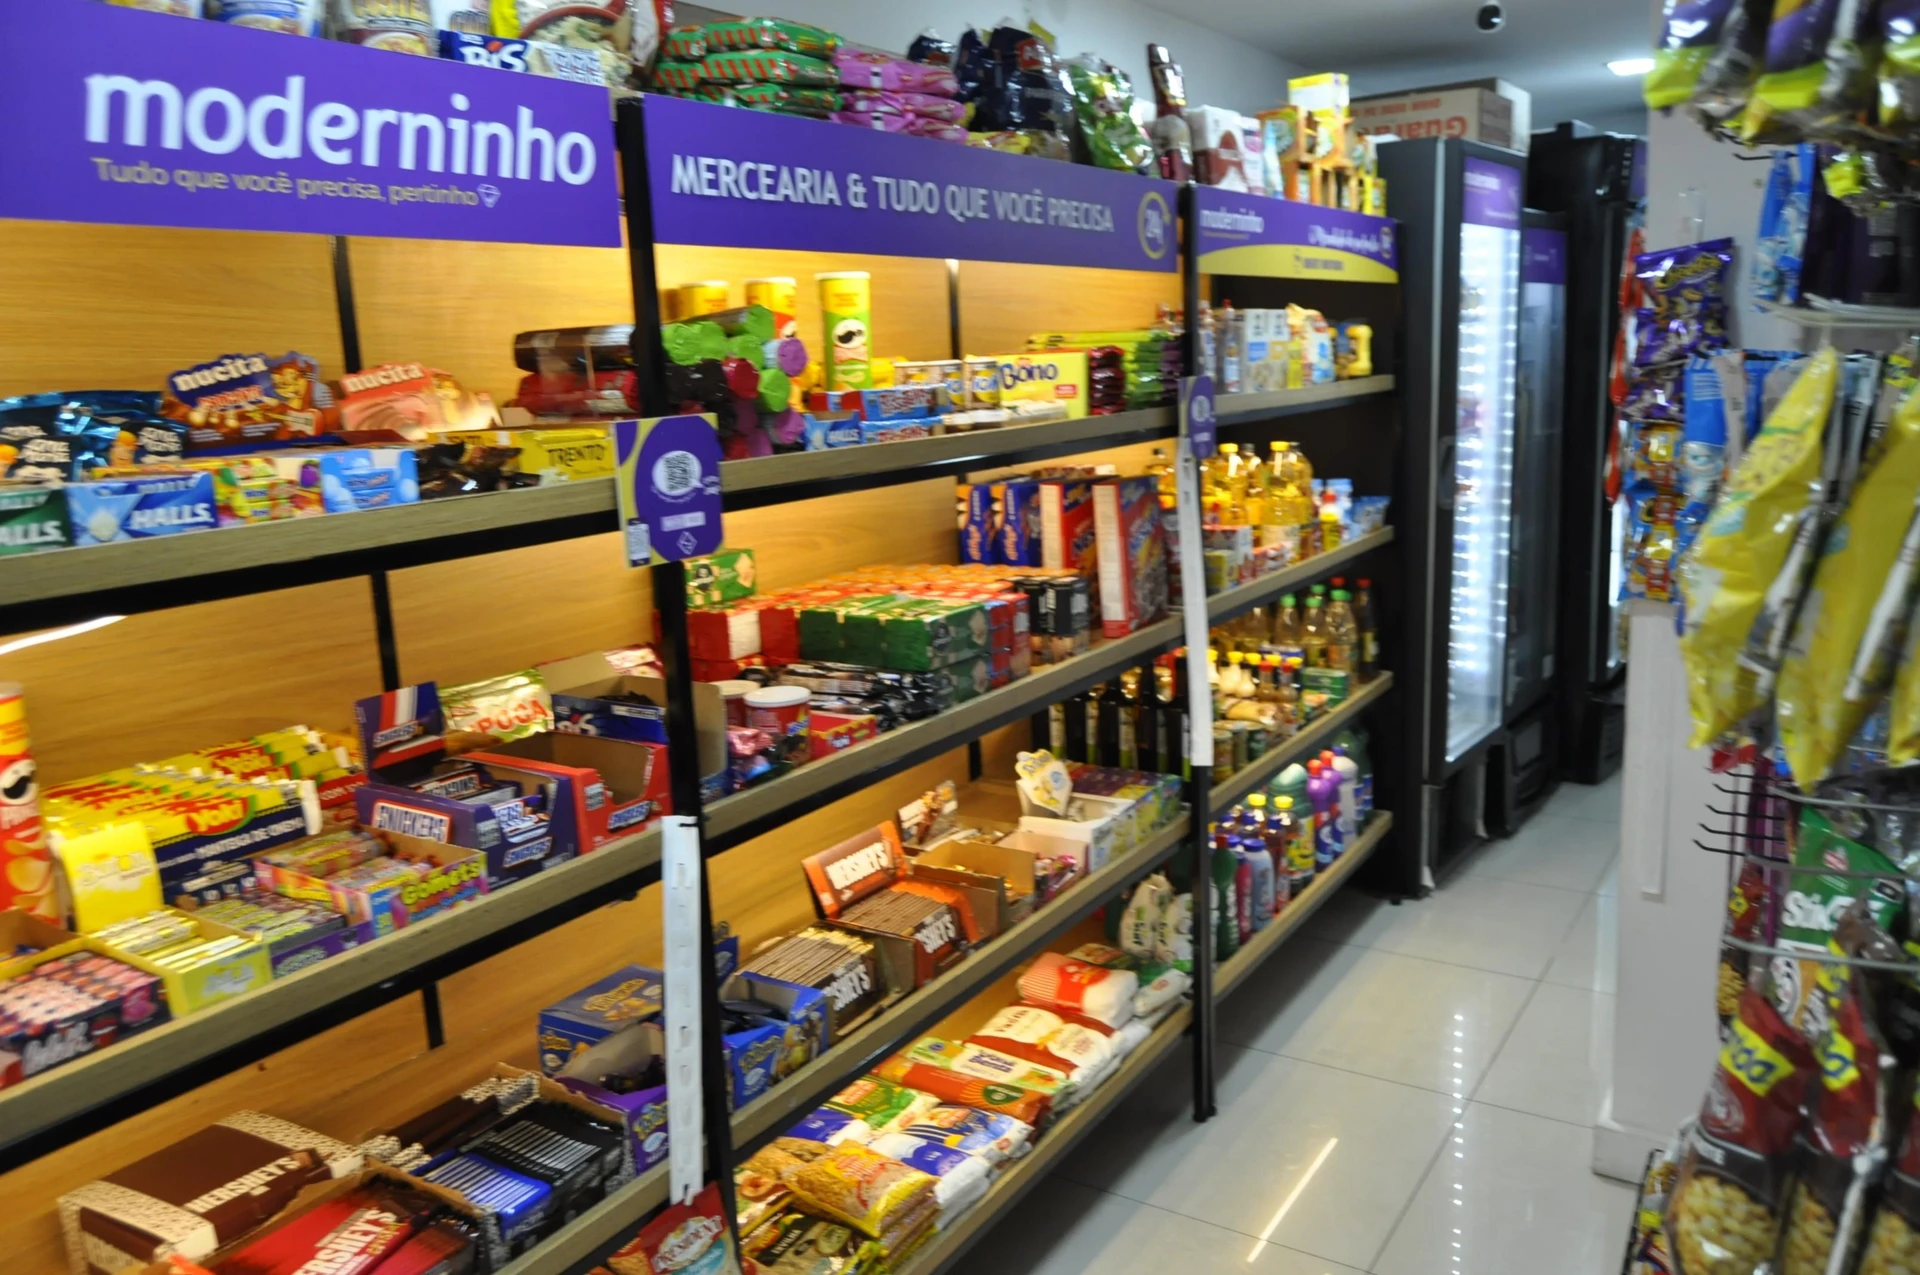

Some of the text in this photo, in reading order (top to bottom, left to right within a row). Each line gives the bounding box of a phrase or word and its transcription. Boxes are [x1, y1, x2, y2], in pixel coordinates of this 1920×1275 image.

[84, 73, 597, 186] moderninho
[93, 157, 479, 206] Tudo que você precisa, pertinho
[671, 154, 1114, 232] MERCEARIA & TUDO QUE VOCÊ PRECISA
[173, 356, 268, 391] nucita
[343, 363, 424, 392] nucita
[999, 363, 1058, 389] Bono
[547, 444, 605, 468] TRENTO
[130, 503, 214, 528] HALLS
[375, 804, 447, 844] SNICKERS
[186, 1157, 302, 1213] HERSHEY'S
[291, 1207, 398, 1275] ERSHEY'S
